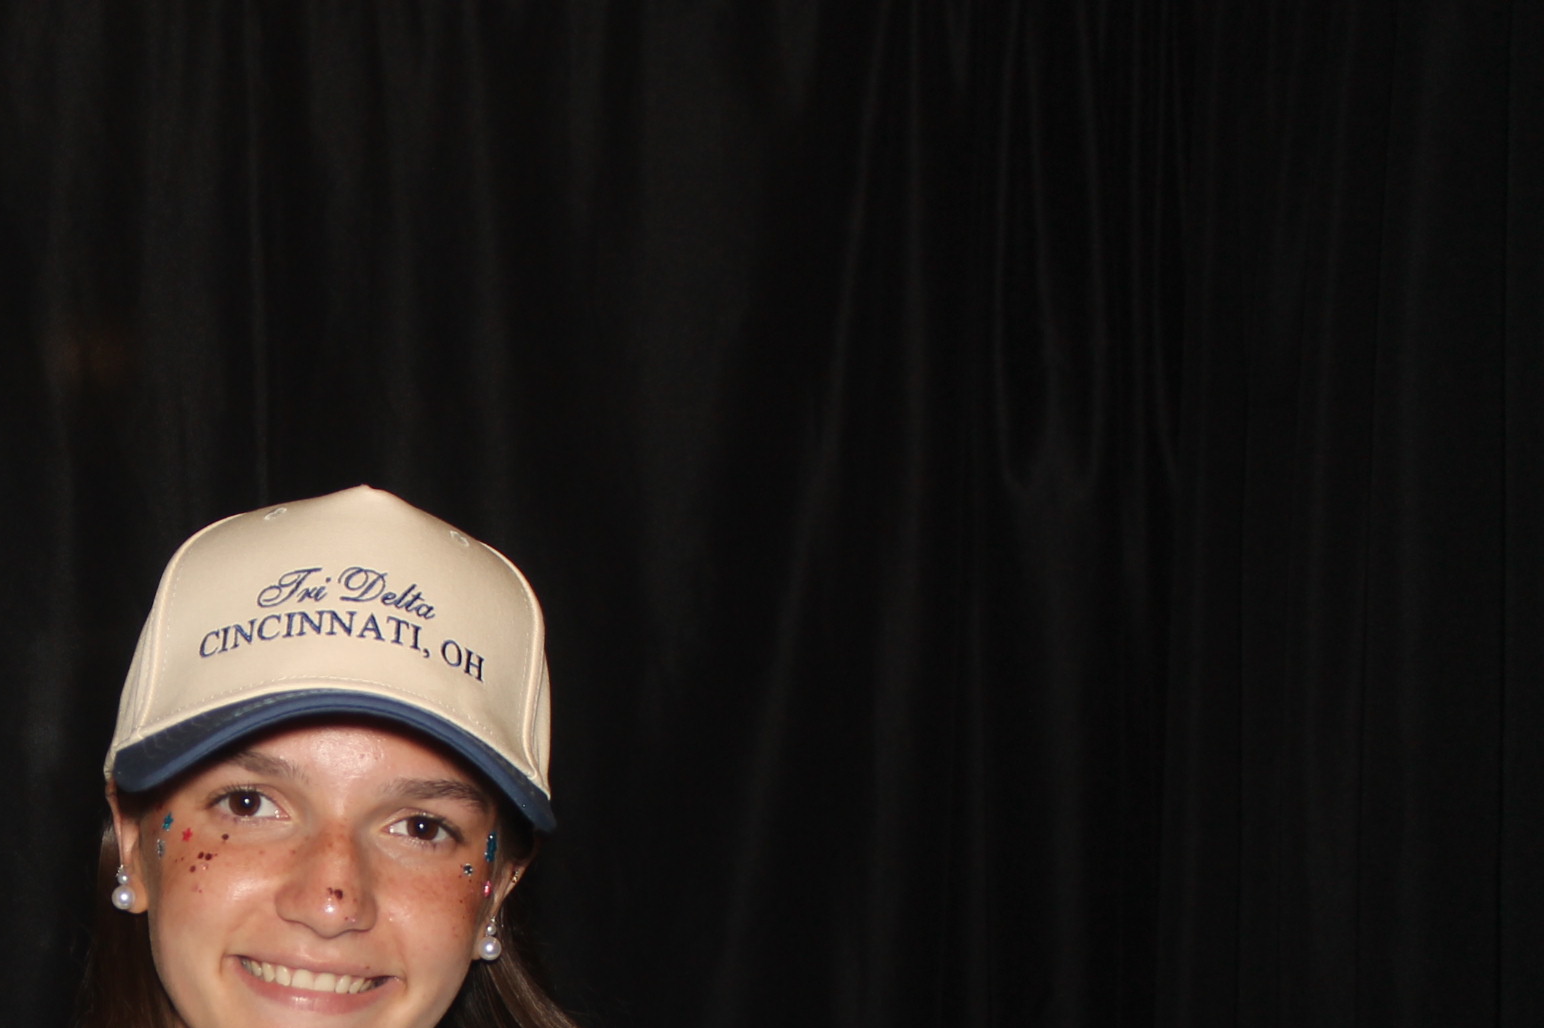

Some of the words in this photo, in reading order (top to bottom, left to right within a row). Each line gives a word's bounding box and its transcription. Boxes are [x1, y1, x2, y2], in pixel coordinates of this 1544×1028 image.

[257, 567, 332, 608] Tri
[337, 567, 437, 620] Delta
[198, 609, 431, 659] CINCINNATI,
[440, 639, 485, 683] OH
